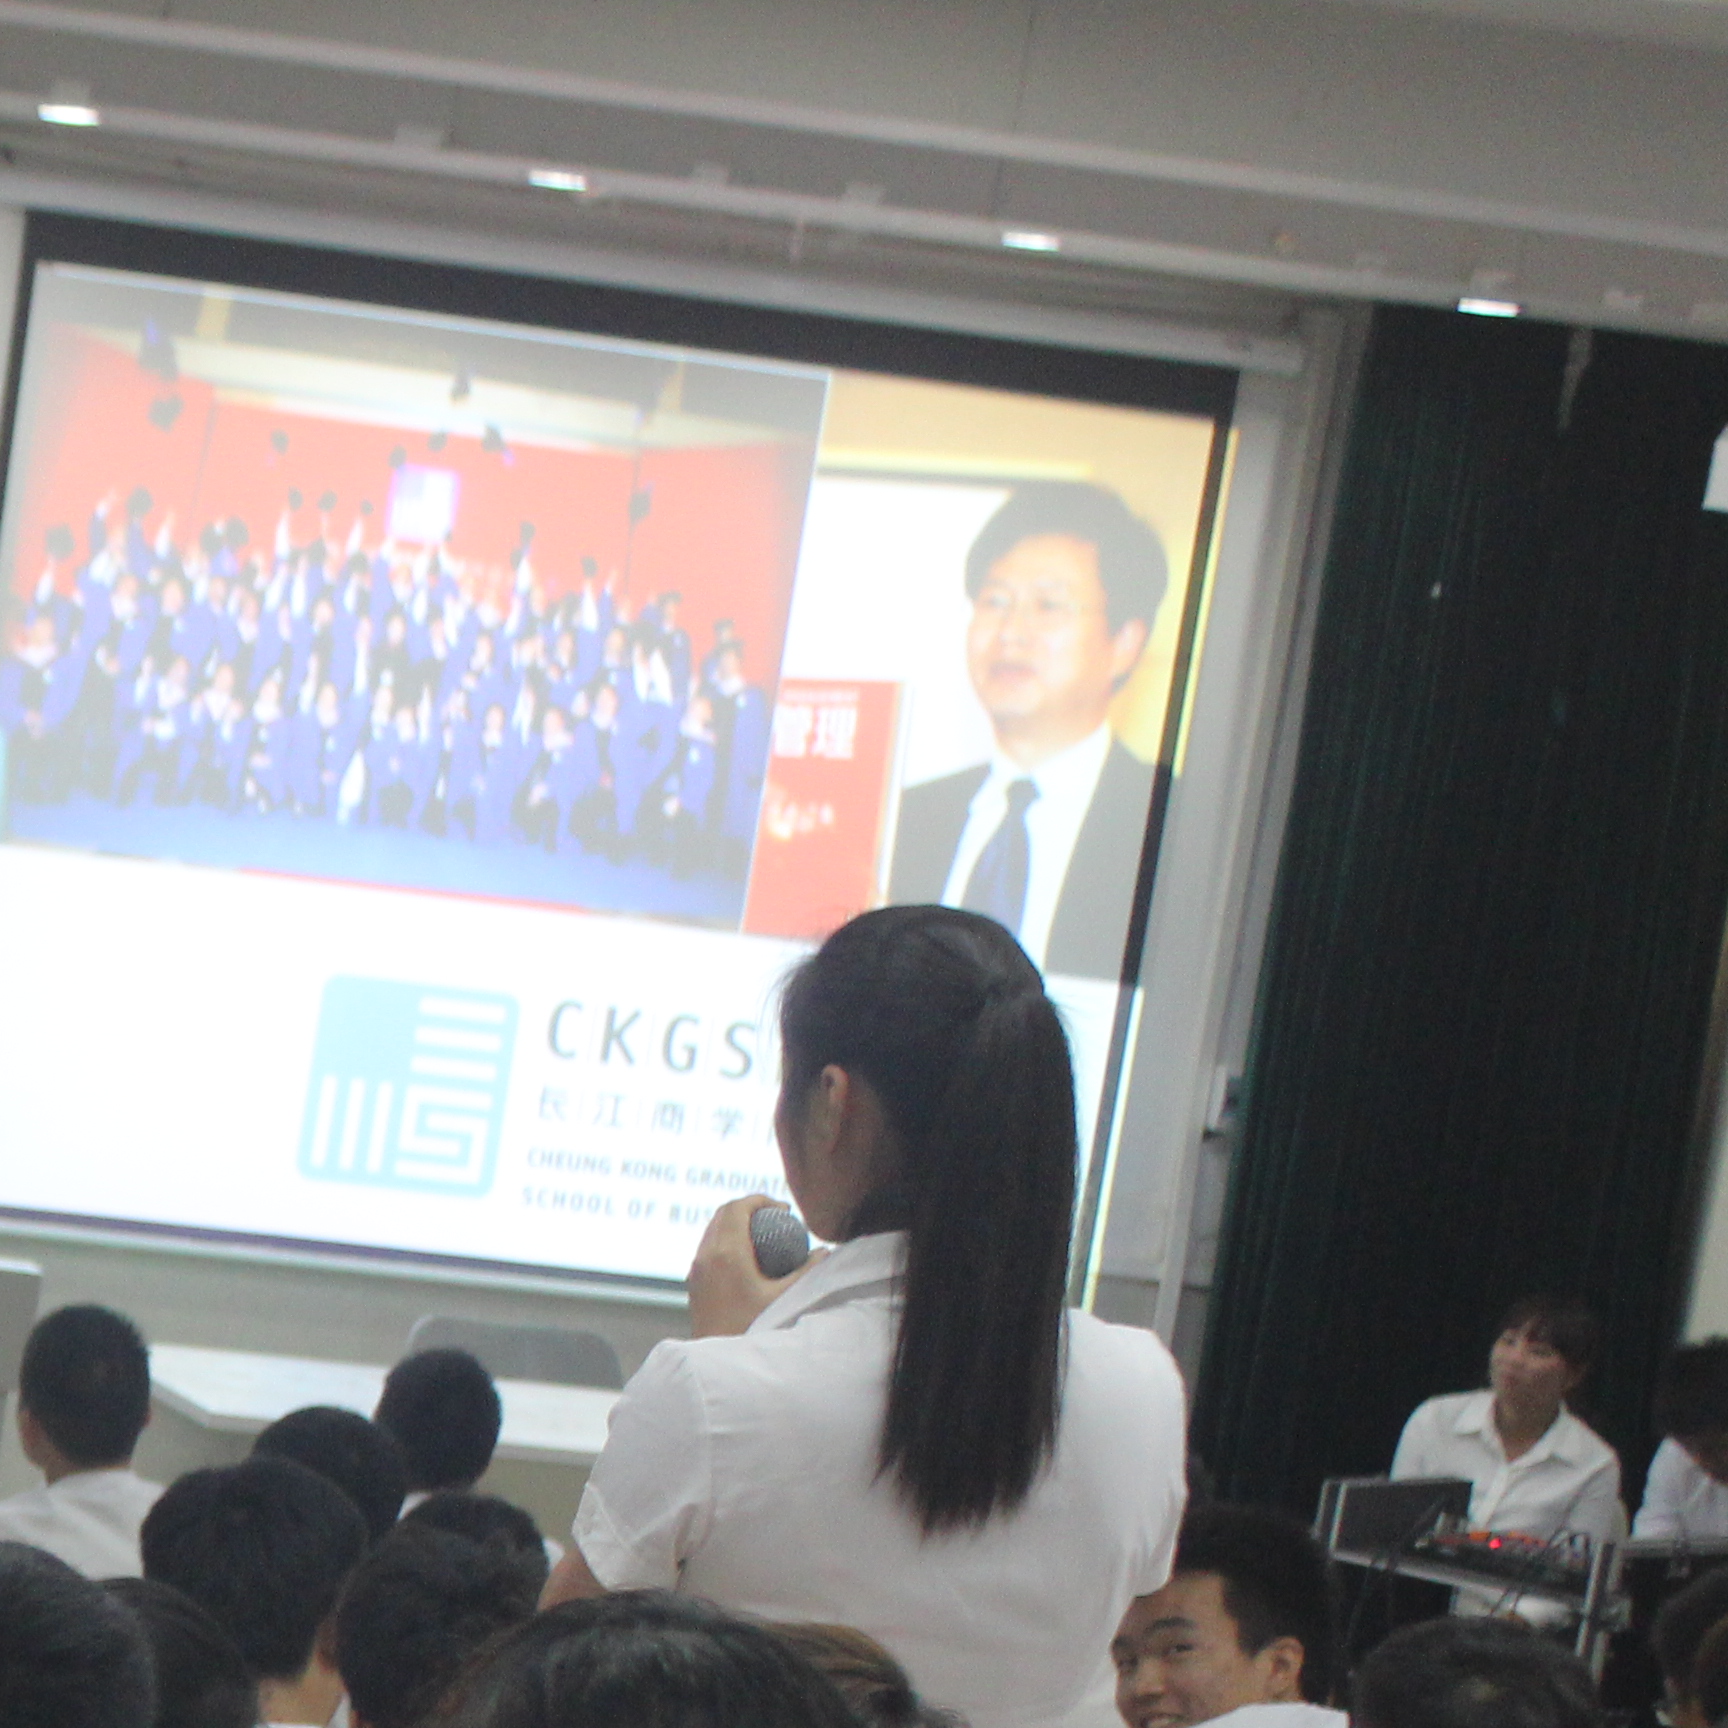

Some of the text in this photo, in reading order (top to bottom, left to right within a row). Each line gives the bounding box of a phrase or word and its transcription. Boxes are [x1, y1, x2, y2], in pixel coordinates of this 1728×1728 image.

[547, 998, 780, 1085] CKGS
[538, 1085, 775, 1145] 长江商学
[527, 1147, 613, 1176] CHEUNG
[621, 1157, 678, 1184] KONG
[522, 1185, 616, 1216] SCHOOL
[627, 1197, 658, 1219] OF
